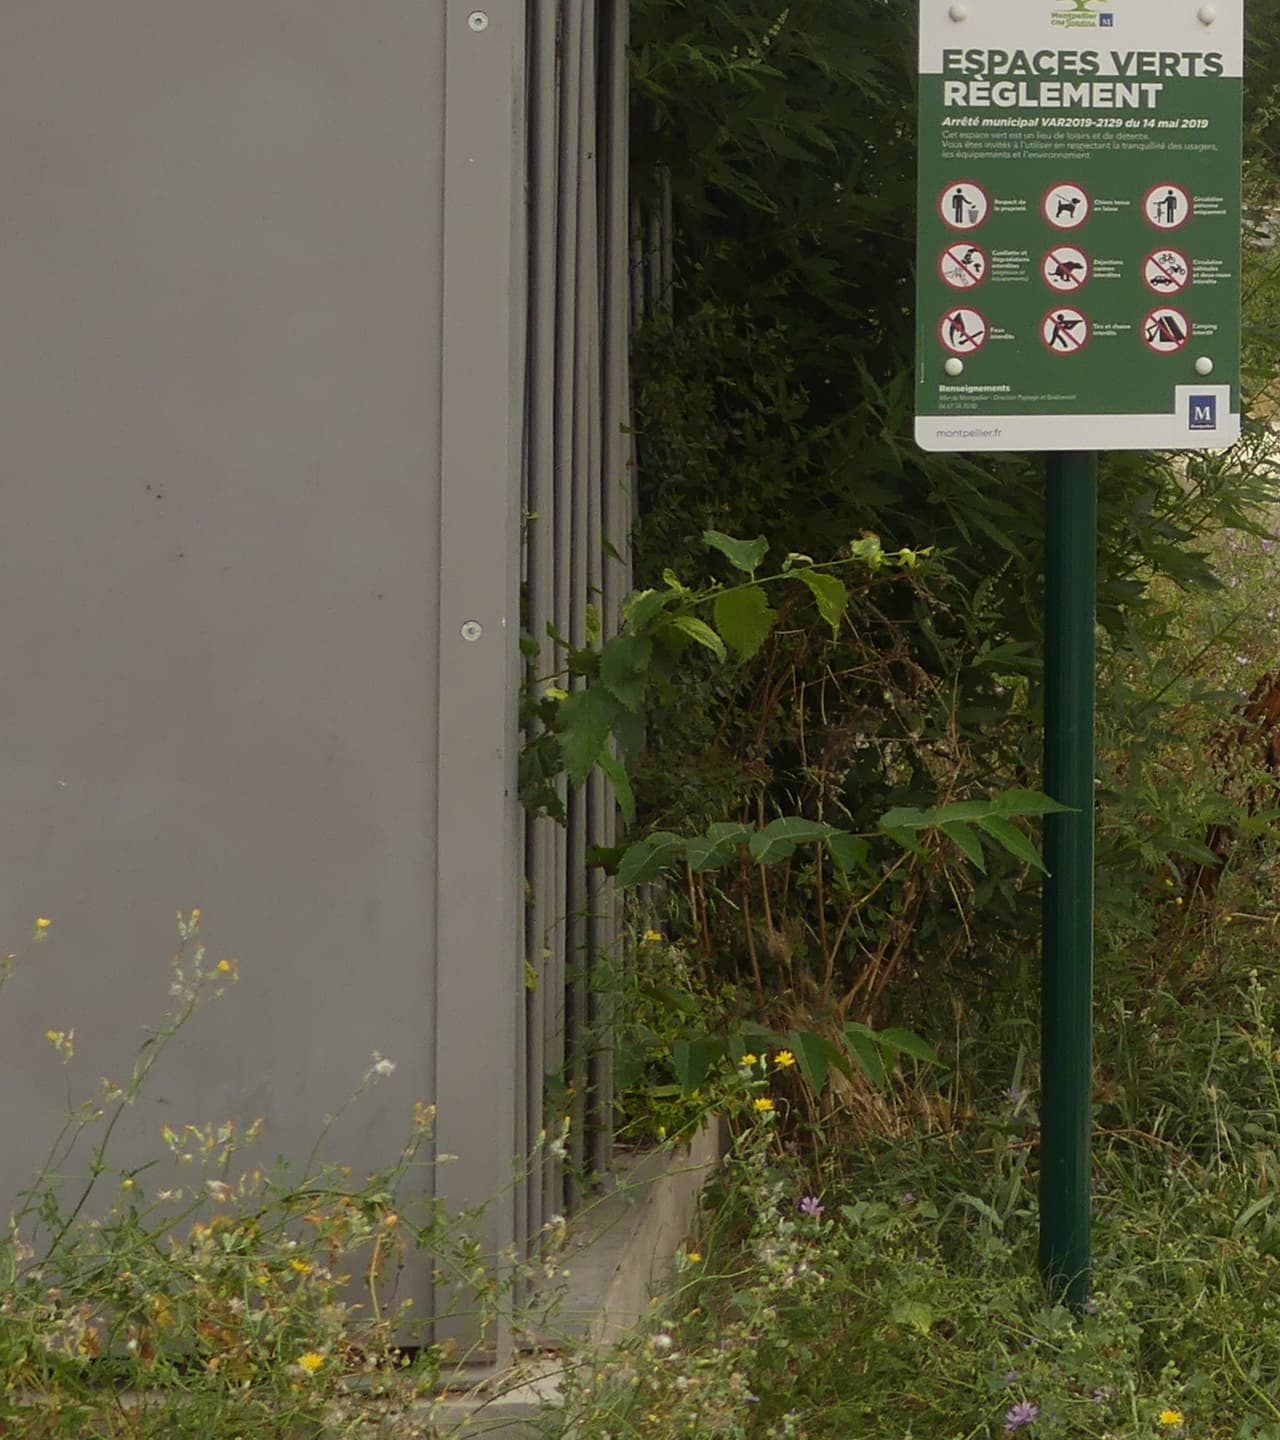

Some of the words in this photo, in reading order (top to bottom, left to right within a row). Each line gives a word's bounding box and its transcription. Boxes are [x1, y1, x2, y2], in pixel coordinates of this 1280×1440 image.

[942, 49, 1100, 77] ESPACES
[1110, 51, 1224, 77] VERTS
[943, 73, 1164, 109] RÈGLEMENT
[942, 116, 980, 127] Arrêté
[981, 117, 1039, 128] municipal
[1041, 117, 1123, 128] VAR2019-2129
[1125, 118, 1140, 128] du
[1142, 119, 1156, 128] 14
[1157, 119, 1180, 128] mai
[1181, 119, 1209, 129] 2019
[938, 384, 1011, 394] Renseignements
[1194, 405, 1212, 421] M
[936, 428, 1003, 439] montpellier.fr
